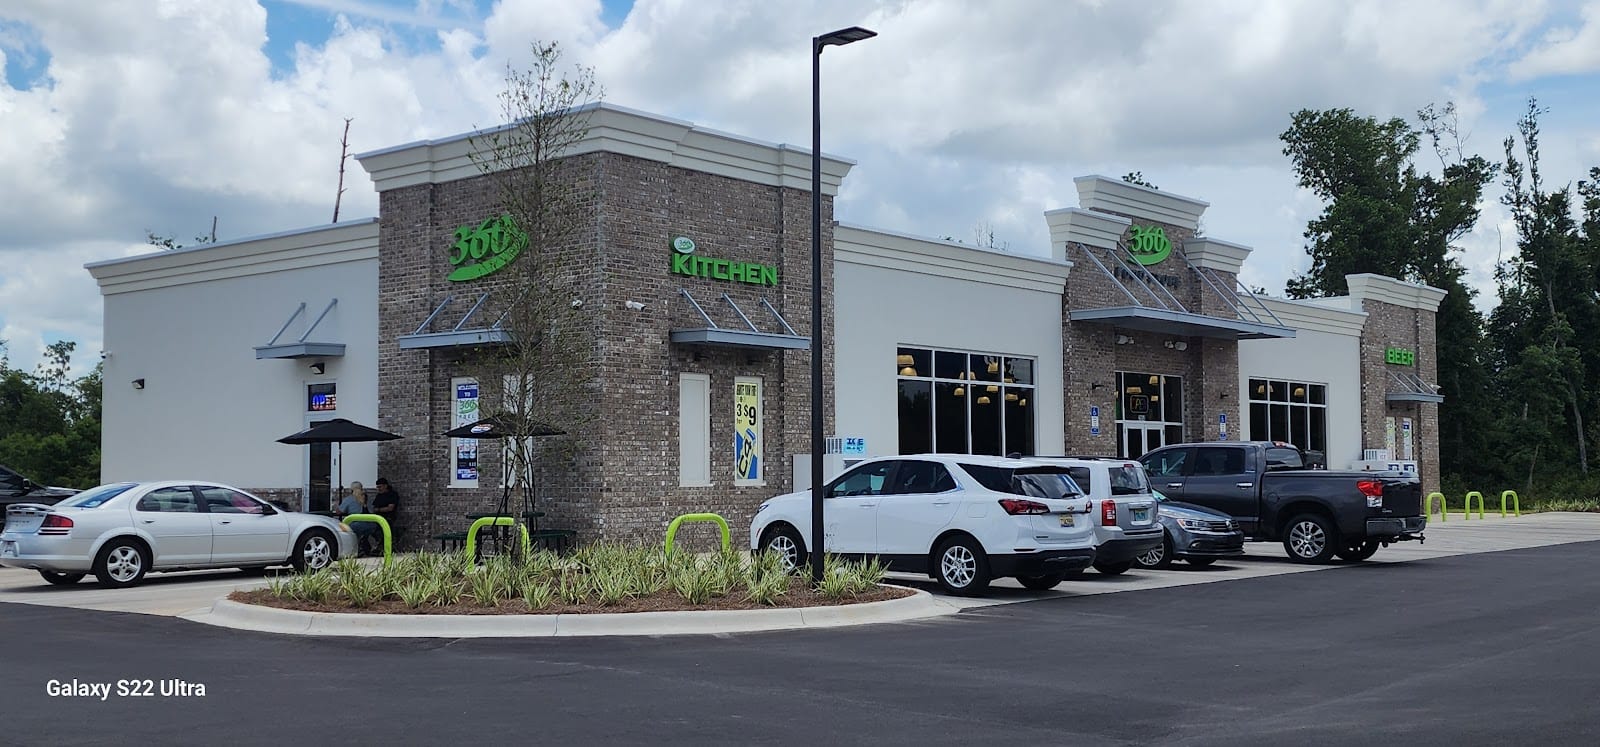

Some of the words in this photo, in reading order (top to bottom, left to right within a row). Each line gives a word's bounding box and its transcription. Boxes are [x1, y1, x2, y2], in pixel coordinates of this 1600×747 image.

[448, 215, 512, 265] 360
[1128, 224, 1166, 252] 360
[672, 253, 778, 286] KITCHEN
[1386, 347, 1415, 367] BEER
[736, 403, 742, 417] 3
[743, 404, 757, 426] $9
[846, 437, 864, 446] ICE
